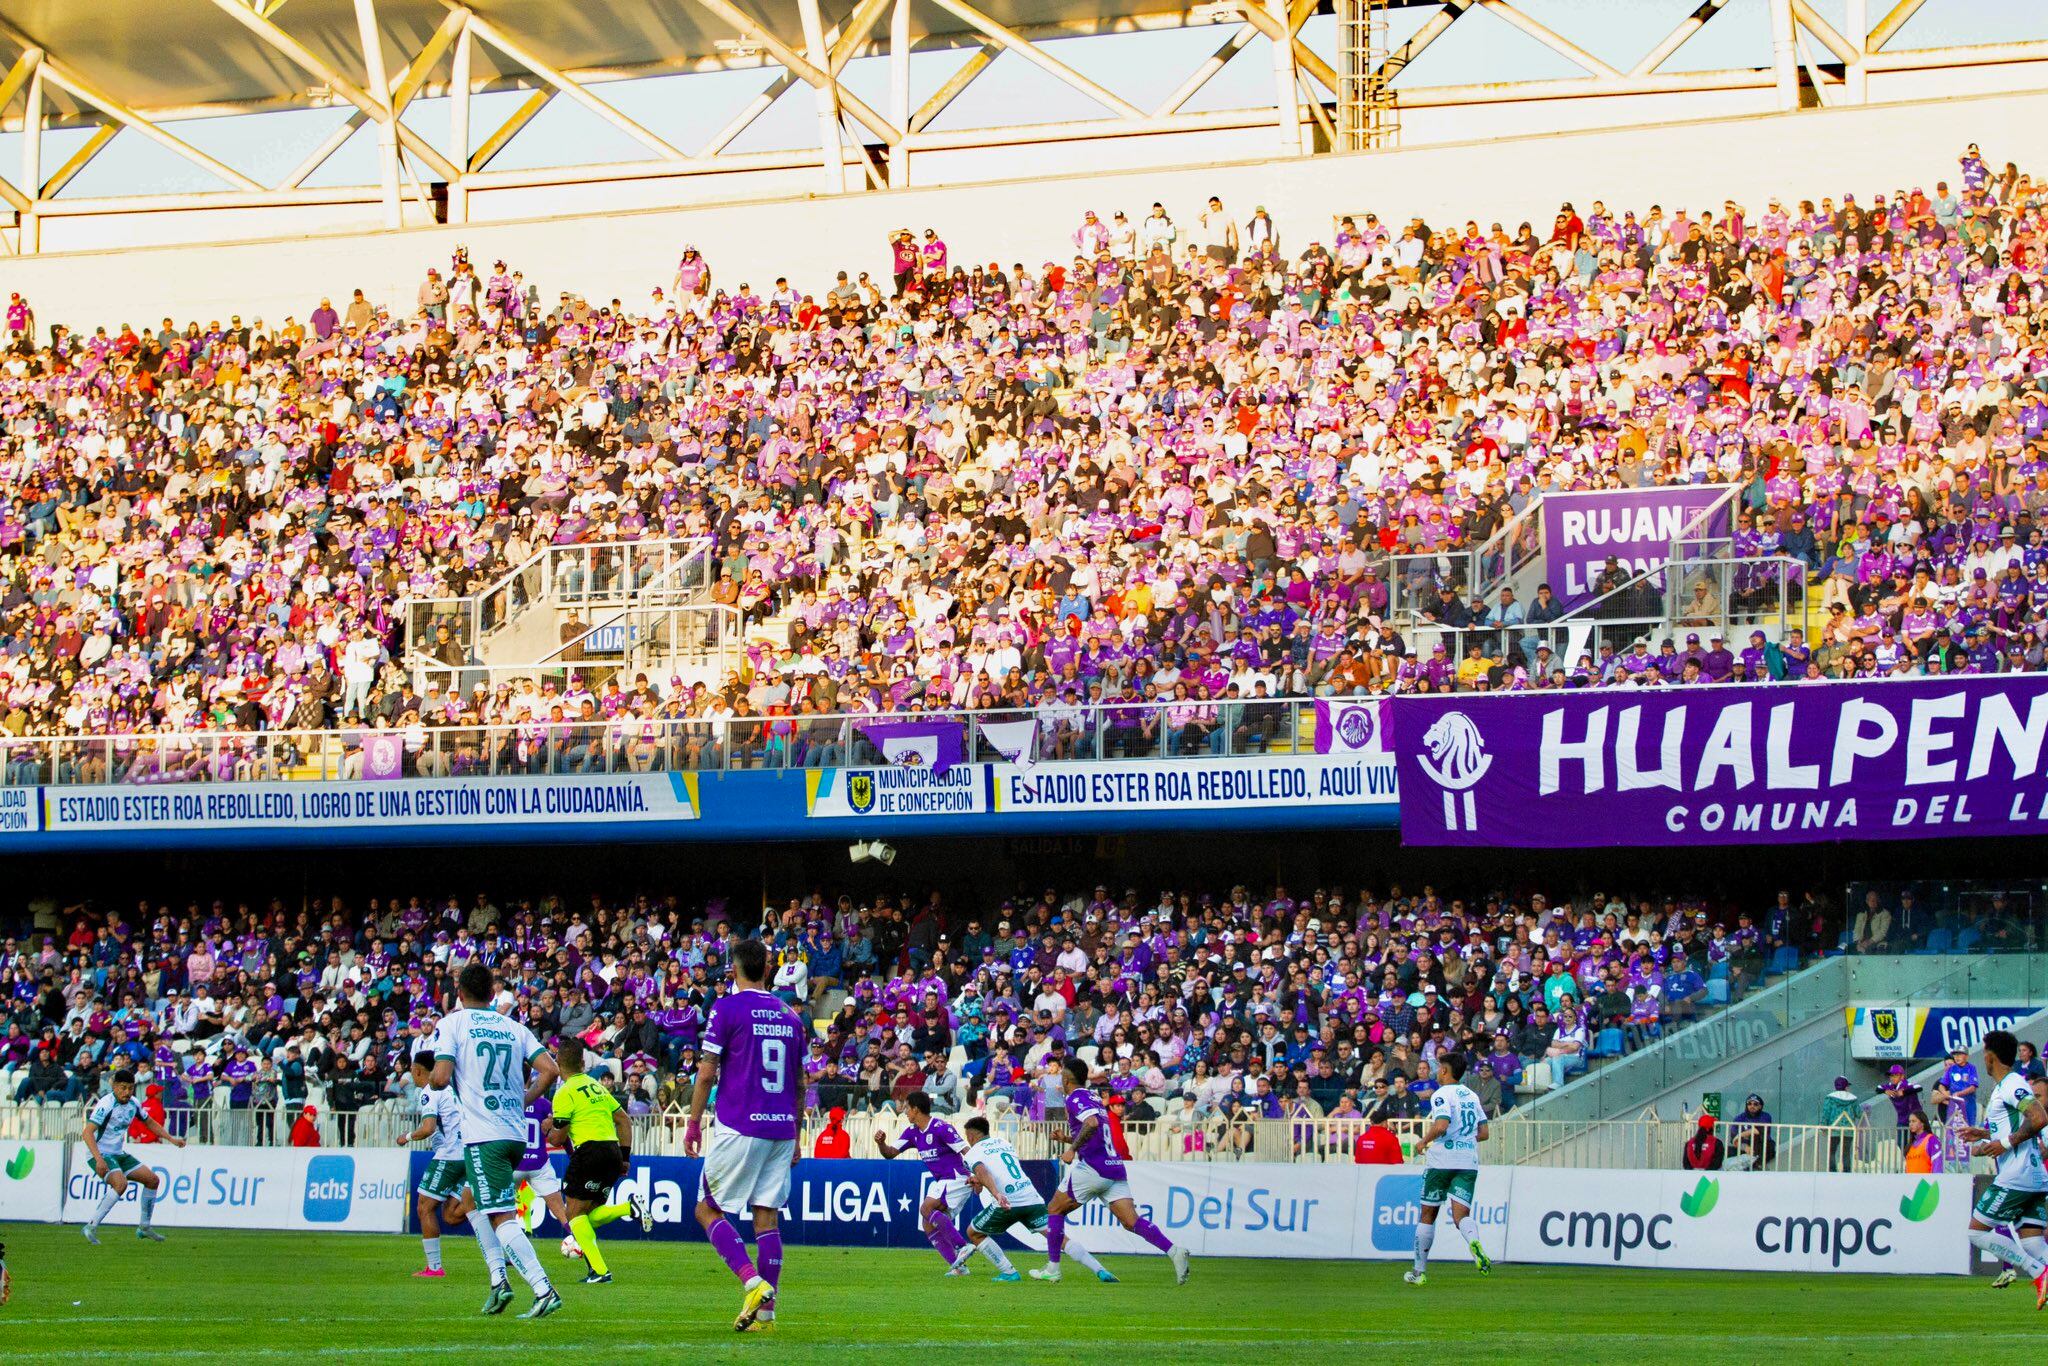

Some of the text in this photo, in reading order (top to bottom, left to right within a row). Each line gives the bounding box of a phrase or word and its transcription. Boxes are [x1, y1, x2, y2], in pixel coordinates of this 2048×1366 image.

[1562, 505, 1682, 547] RUJAN
[59, 780, 649, 822] ESTADIO ESTER ROA REBOLLEDO, LOGRO DE UNA GESTIÓN CON LA CIUDADANÍA.
[880, 787, 973, 812] DE CONCEPCIÓN
[1092, 772, 1149, 803] ESTER
[1155, 771, 1193, 801] ROA
[1197, 767, 1312, 801] REBOLLEDO,
[1319, 760, 1362, 797] AQUÍ
[1665, 797, 1857, 832] COMUNA
[1892, 794, 1973, 826] DEL
[751, 1009, 783, 1021] cmpc
[752, 1023, 793, 1038] ESCOBAR
[469, 1028, 516, 1042] SERRANO
[476, 1041, 513, 1091] 27
[761, 1038, 786, 1094] 9
[1000, 1152, 1022, 1180] 8
[69, 1166, 265, 1207] Clína Del Sur
[308, 1178, 350, 1201] achs
[358, 1177, 408, 1200] salud
[802, 1180, 892, 1223] LIGA
[1166, 1185, 1233, 1230] Del
[1244, 1187, 1319, 1232] Sur
[1378, 1202, 1421, 1227] ach
[1444, 1200, 1508, 1226] slud
[1539, 1210, 1673, 1261] cmpc
[1755, 1215, 1893, 1268] cmpc
